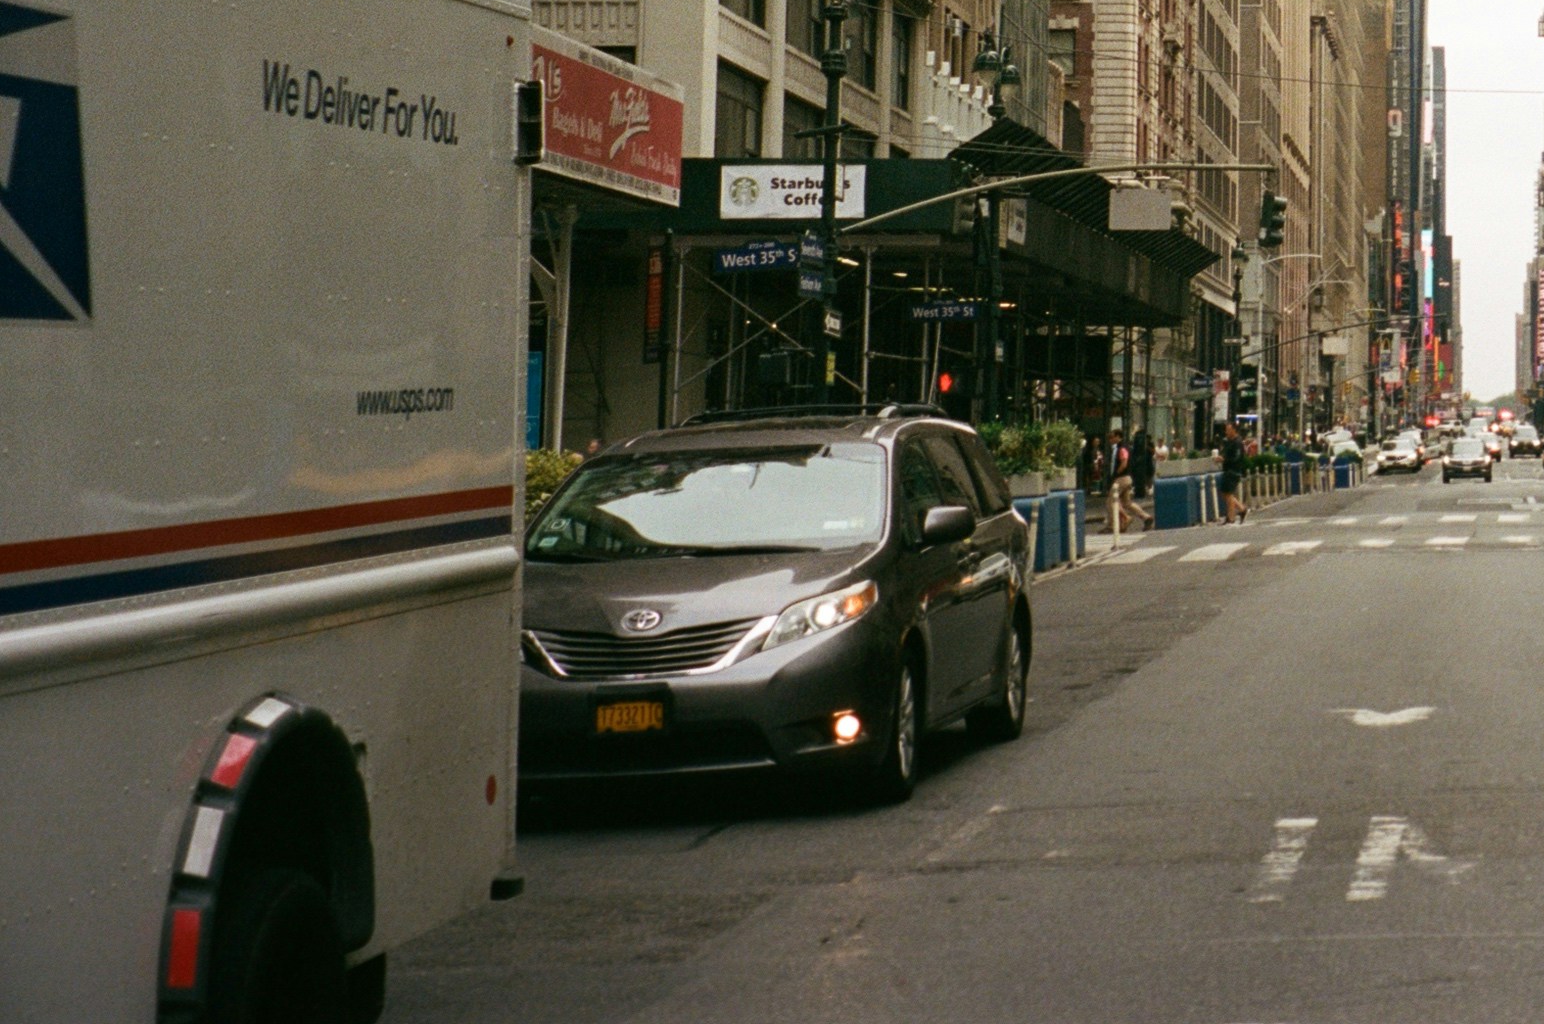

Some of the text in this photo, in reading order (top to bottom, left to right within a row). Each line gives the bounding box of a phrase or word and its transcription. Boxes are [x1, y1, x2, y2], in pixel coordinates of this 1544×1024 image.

[263, 59, 458, 145] We Deliver For You.
[770, 177, 850, 190] Starbus
[784, 194, 823, 206] Coff
[721, 248, 797, 268] West 35th S
[912, 306, 974, 318] West 35th St
[357, 387, 454, 421] www.usps.com
